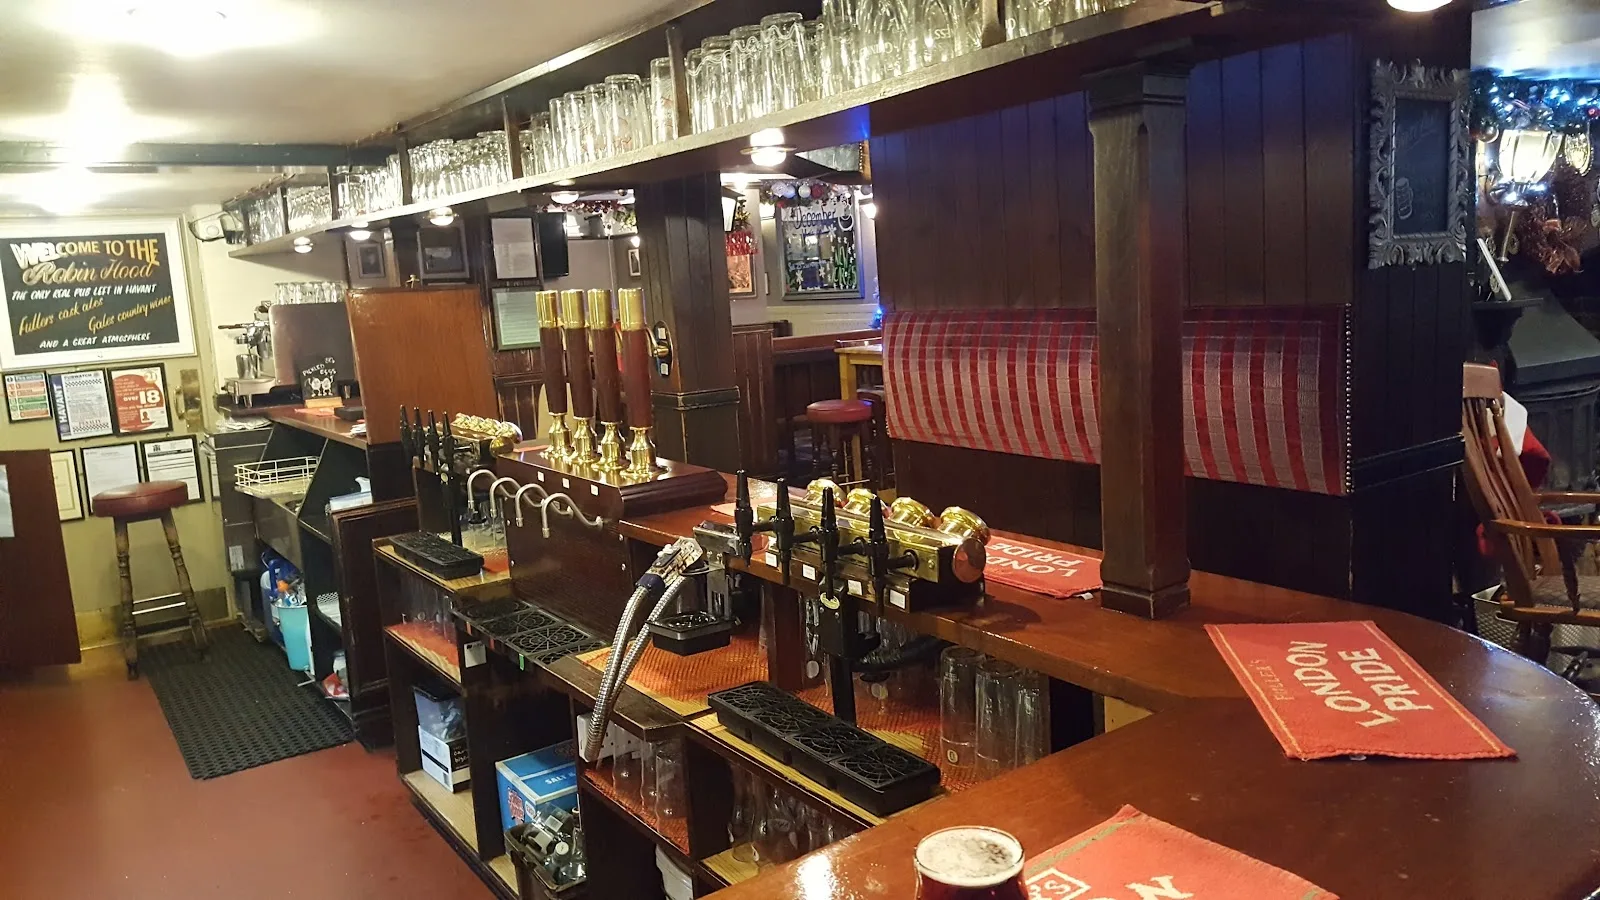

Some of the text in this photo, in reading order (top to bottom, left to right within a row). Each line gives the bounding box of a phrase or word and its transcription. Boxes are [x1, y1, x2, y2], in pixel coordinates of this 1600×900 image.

[794, 206, 837, 230] December
[9, 239, 160, 270] WELCOME TO THE
[22, 258, 154, 286] Robin Hood
[11, 283, 157, 301] THE ONLY REAL PUB LEFT IN HAVANT
[19, 296, 104, 336] Fullers cask ales
[88, 295, 172, 335] Gales country wines
[39, 332, 151, 349] AND A GREAT ATMOSPHERE
[302, 363, 325, 377] PICKLED
[53, 383, 68, 423] HAVANT
[139, 389, 161, 405] 18
[986, 554, 1078, 577] LOND
[990, 542, 1084, 567] PRIDE
[1286, 640, 1401, 729] LONDON
[1338, 647, 1434, 711] PRIDE
[544, 775, 567, 785] SALT
